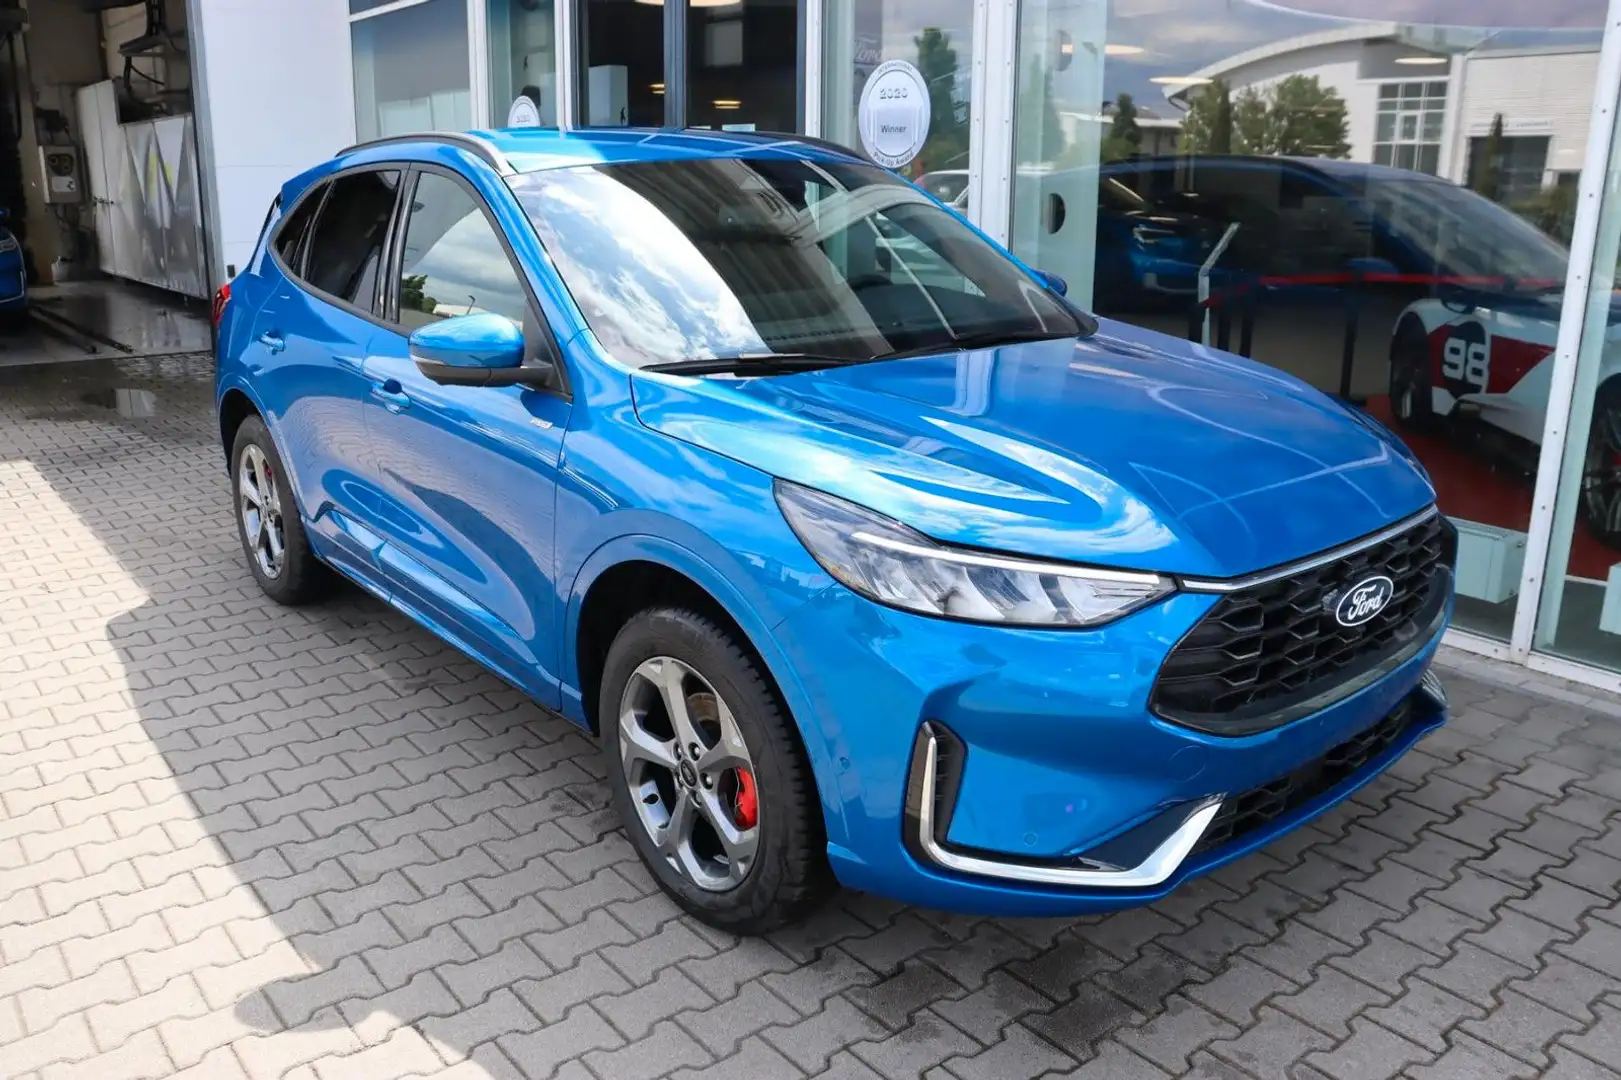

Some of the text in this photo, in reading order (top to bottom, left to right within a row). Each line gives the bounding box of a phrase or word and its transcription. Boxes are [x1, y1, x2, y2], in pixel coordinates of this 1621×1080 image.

[879, 88, 909, 99] 2020
[880, 125, 907, 134] Winner
[1442, 336, 1489, 386] 98
[1347, 584, 1385, 620] Ford
